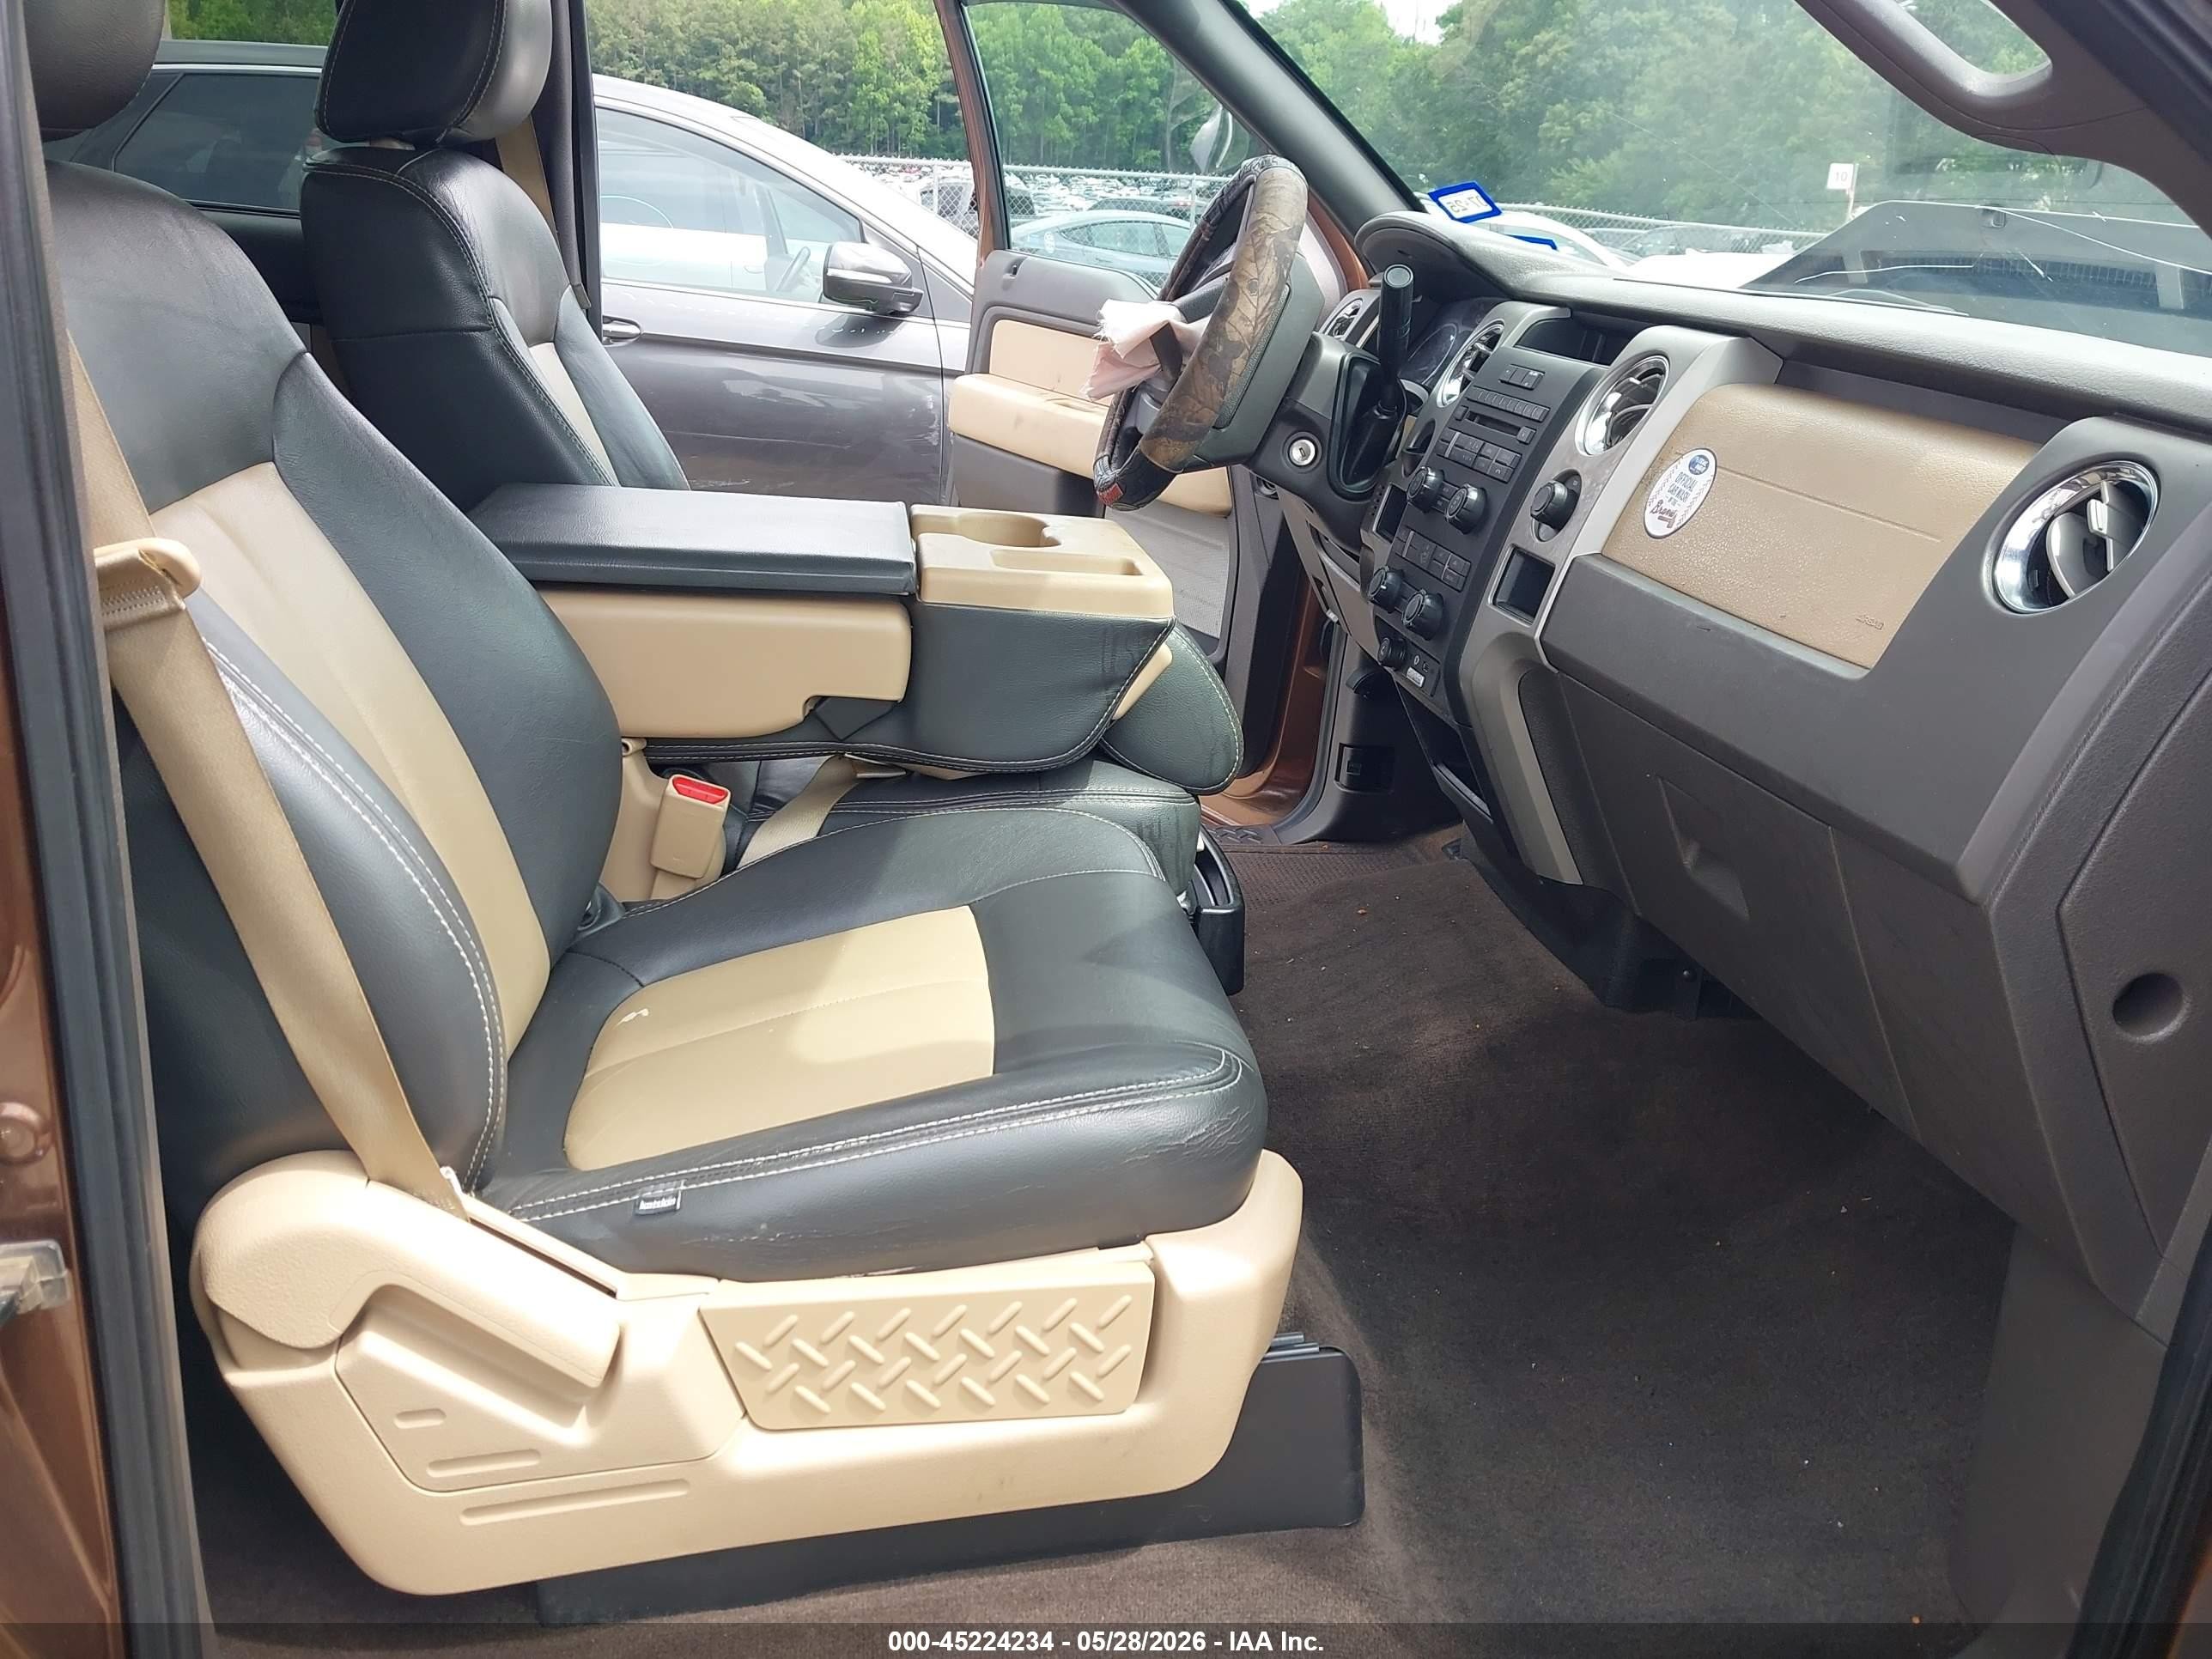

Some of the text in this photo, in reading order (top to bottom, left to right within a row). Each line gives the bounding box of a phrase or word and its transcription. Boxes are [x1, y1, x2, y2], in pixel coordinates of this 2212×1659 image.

[1674, 471, 1698, 493] OFFICIAL
[1667, 483, 1678, 496] CAR
[1676, 488, 1692, 502] WASH
